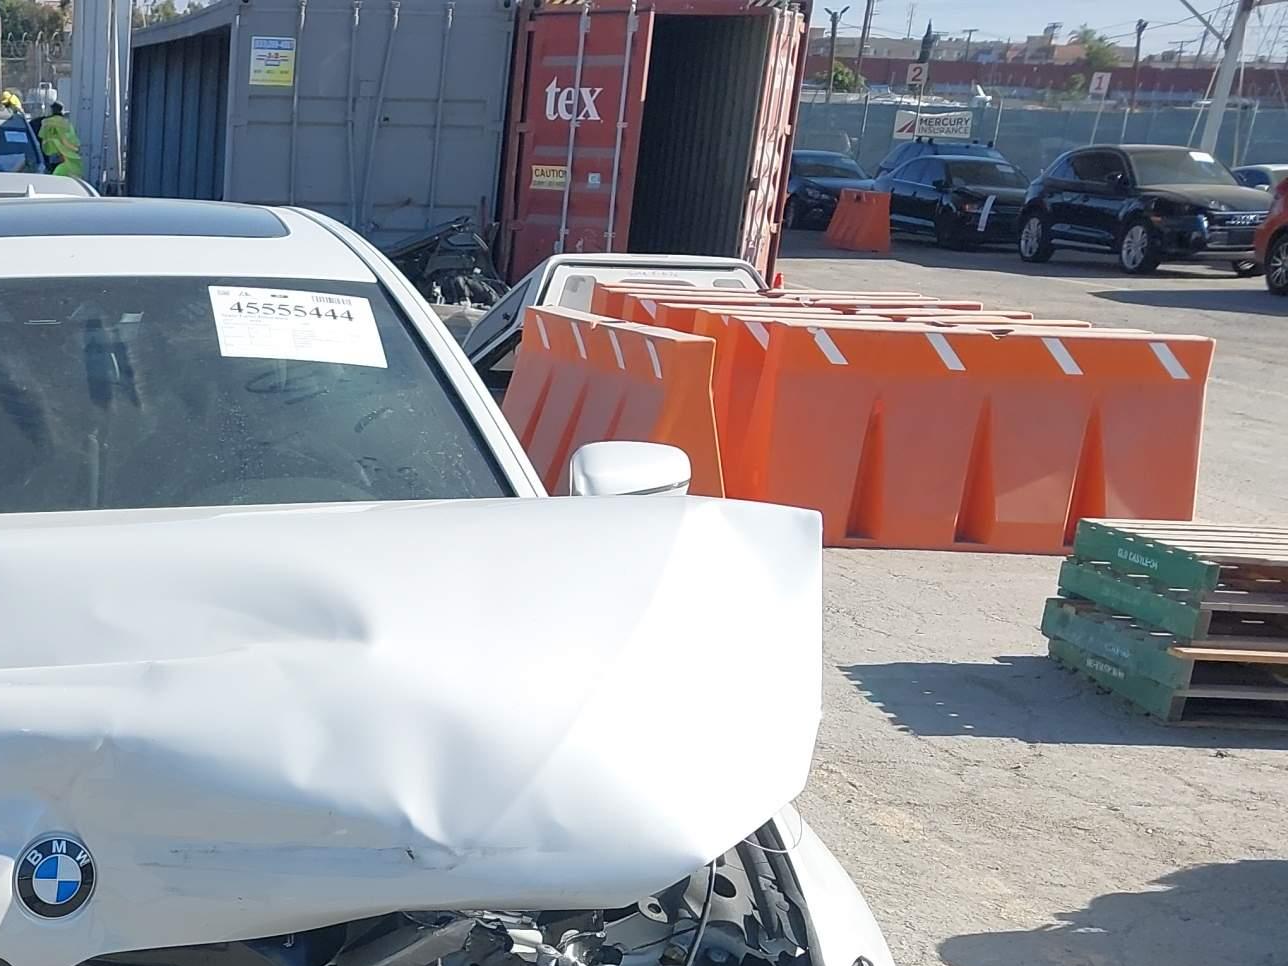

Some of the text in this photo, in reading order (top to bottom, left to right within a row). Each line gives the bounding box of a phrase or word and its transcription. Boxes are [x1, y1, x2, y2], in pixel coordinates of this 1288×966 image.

[912, 66, 923, 81] 2
[1095, 76, 1103, 90] 1
[545, 76, 604, 121] tex
[919, 118, 970, 127] MERCURY
[918, 126, 969, 135] INSURANCE
[229, 301, 354, 322] 45555444
[26, 840, 90, 868] BMW
